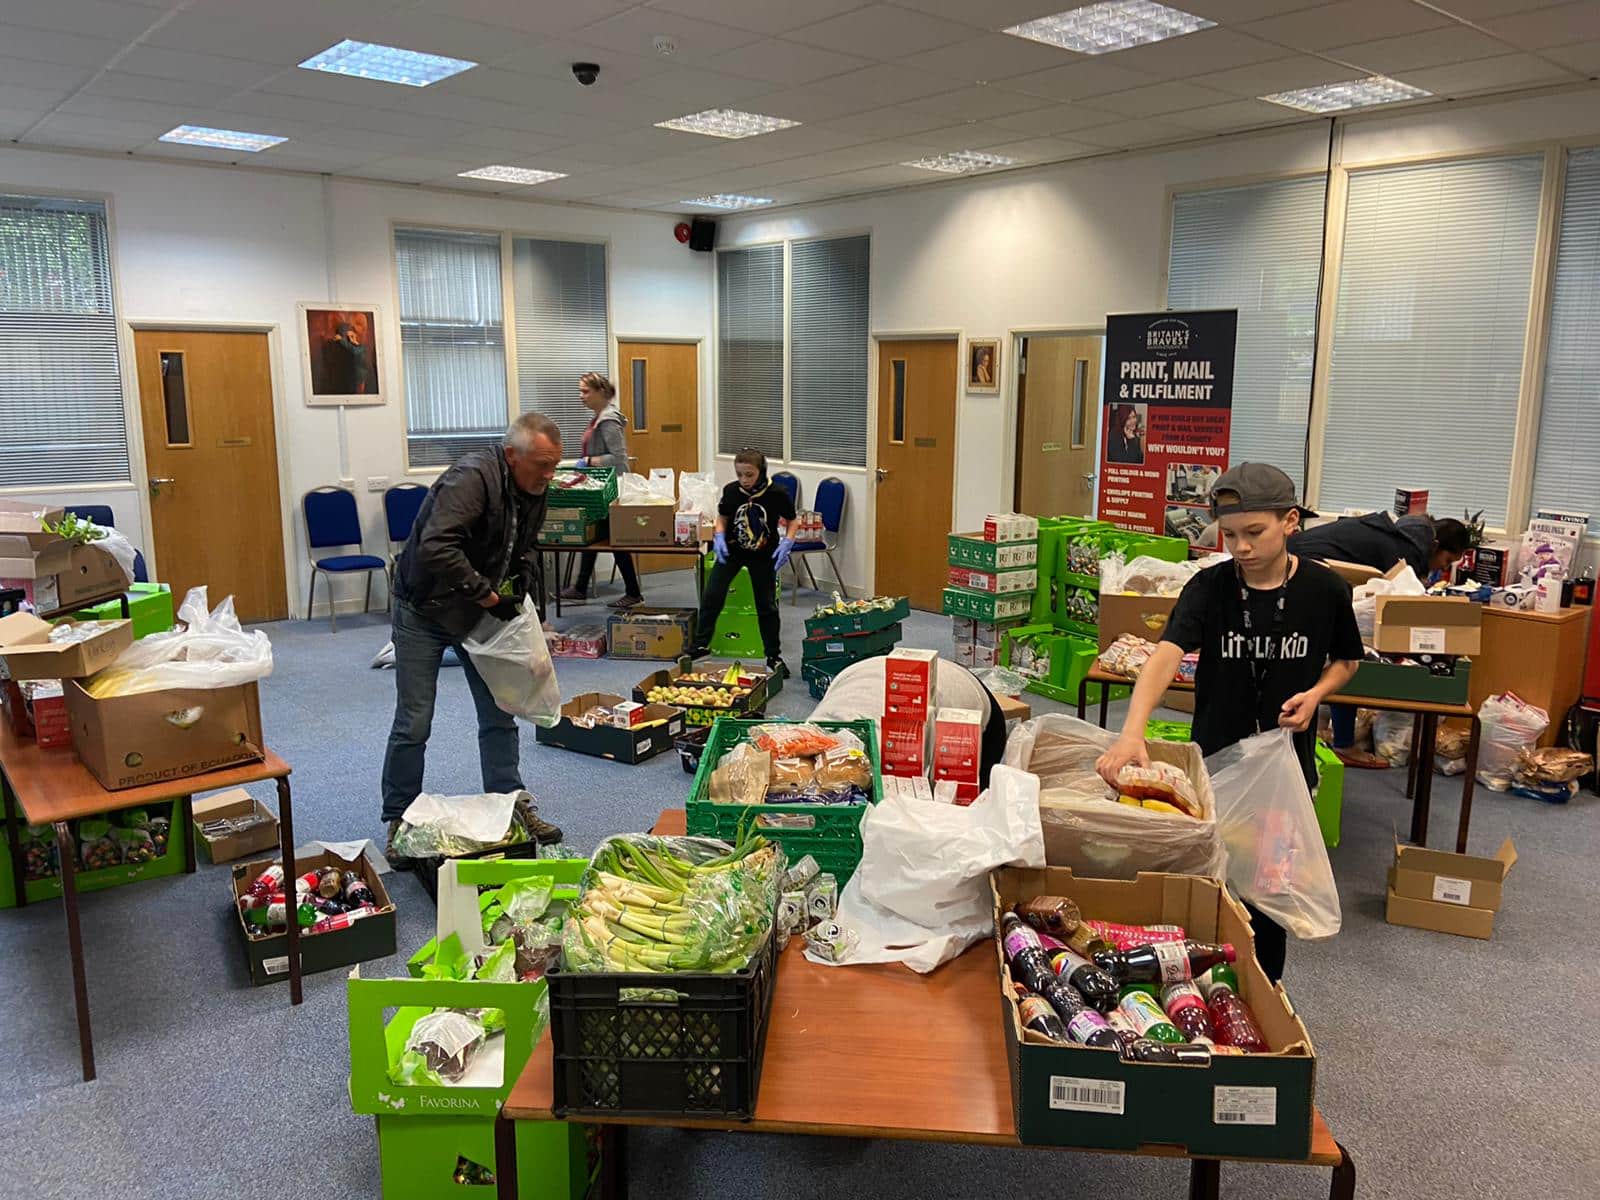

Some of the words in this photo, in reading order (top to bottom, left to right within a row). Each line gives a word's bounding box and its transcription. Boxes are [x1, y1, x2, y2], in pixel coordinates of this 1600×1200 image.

[1147, 330, 1190, 338] BRITAIN'S
[1147, 337, 1189, 346] BRAVEST
[1120, 361, 1168, 382] PRINT,
[1173, 361, 1215, 379] MAIL
[1119, 384, 1129, 398] &
[1132, 384, 1213, 400] FULFILMENT
[1147, 443, 1165, 453] WHY
[1166, 445, 1204, 455] WOULDN'T
[1205, 447, 1226, 457] YOU?
[119, 768, 177, 786] PRODUCT
[181, 763, 197, 774] OF
